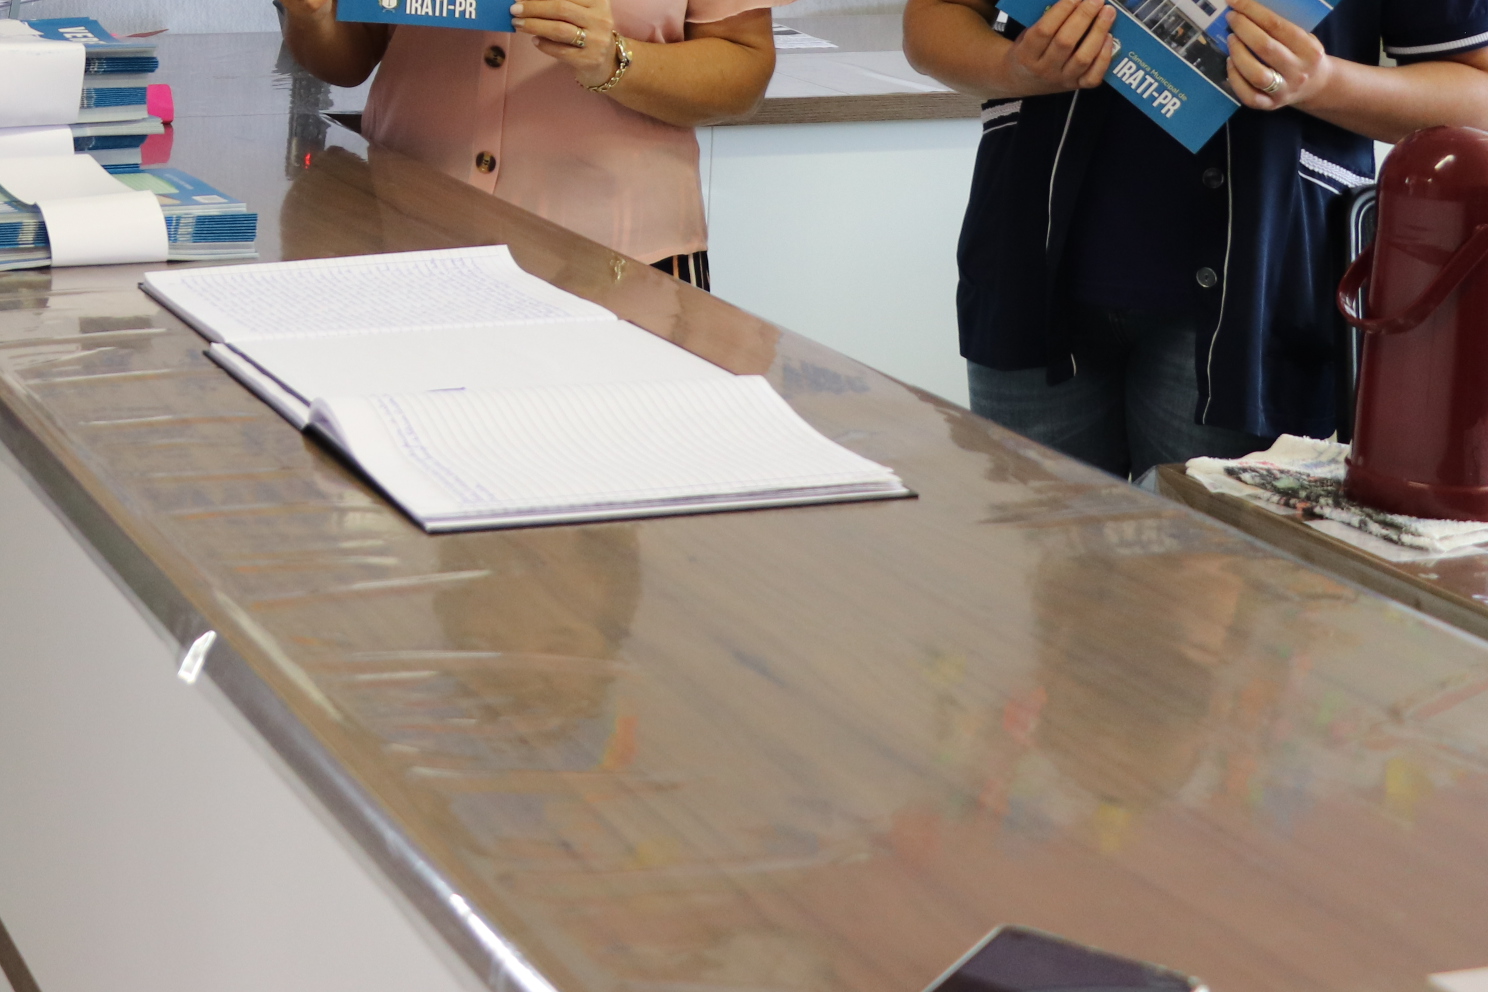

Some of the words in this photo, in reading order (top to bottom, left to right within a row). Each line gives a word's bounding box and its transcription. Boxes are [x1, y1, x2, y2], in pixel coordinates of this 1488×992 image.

[1112, 57, 1181, 118] IRATI-PR
[1128, 51, 1151, 71] Câmara
[1150, 69, 1180, 94] Municipal
[1178, 92, 1188, 101] de
